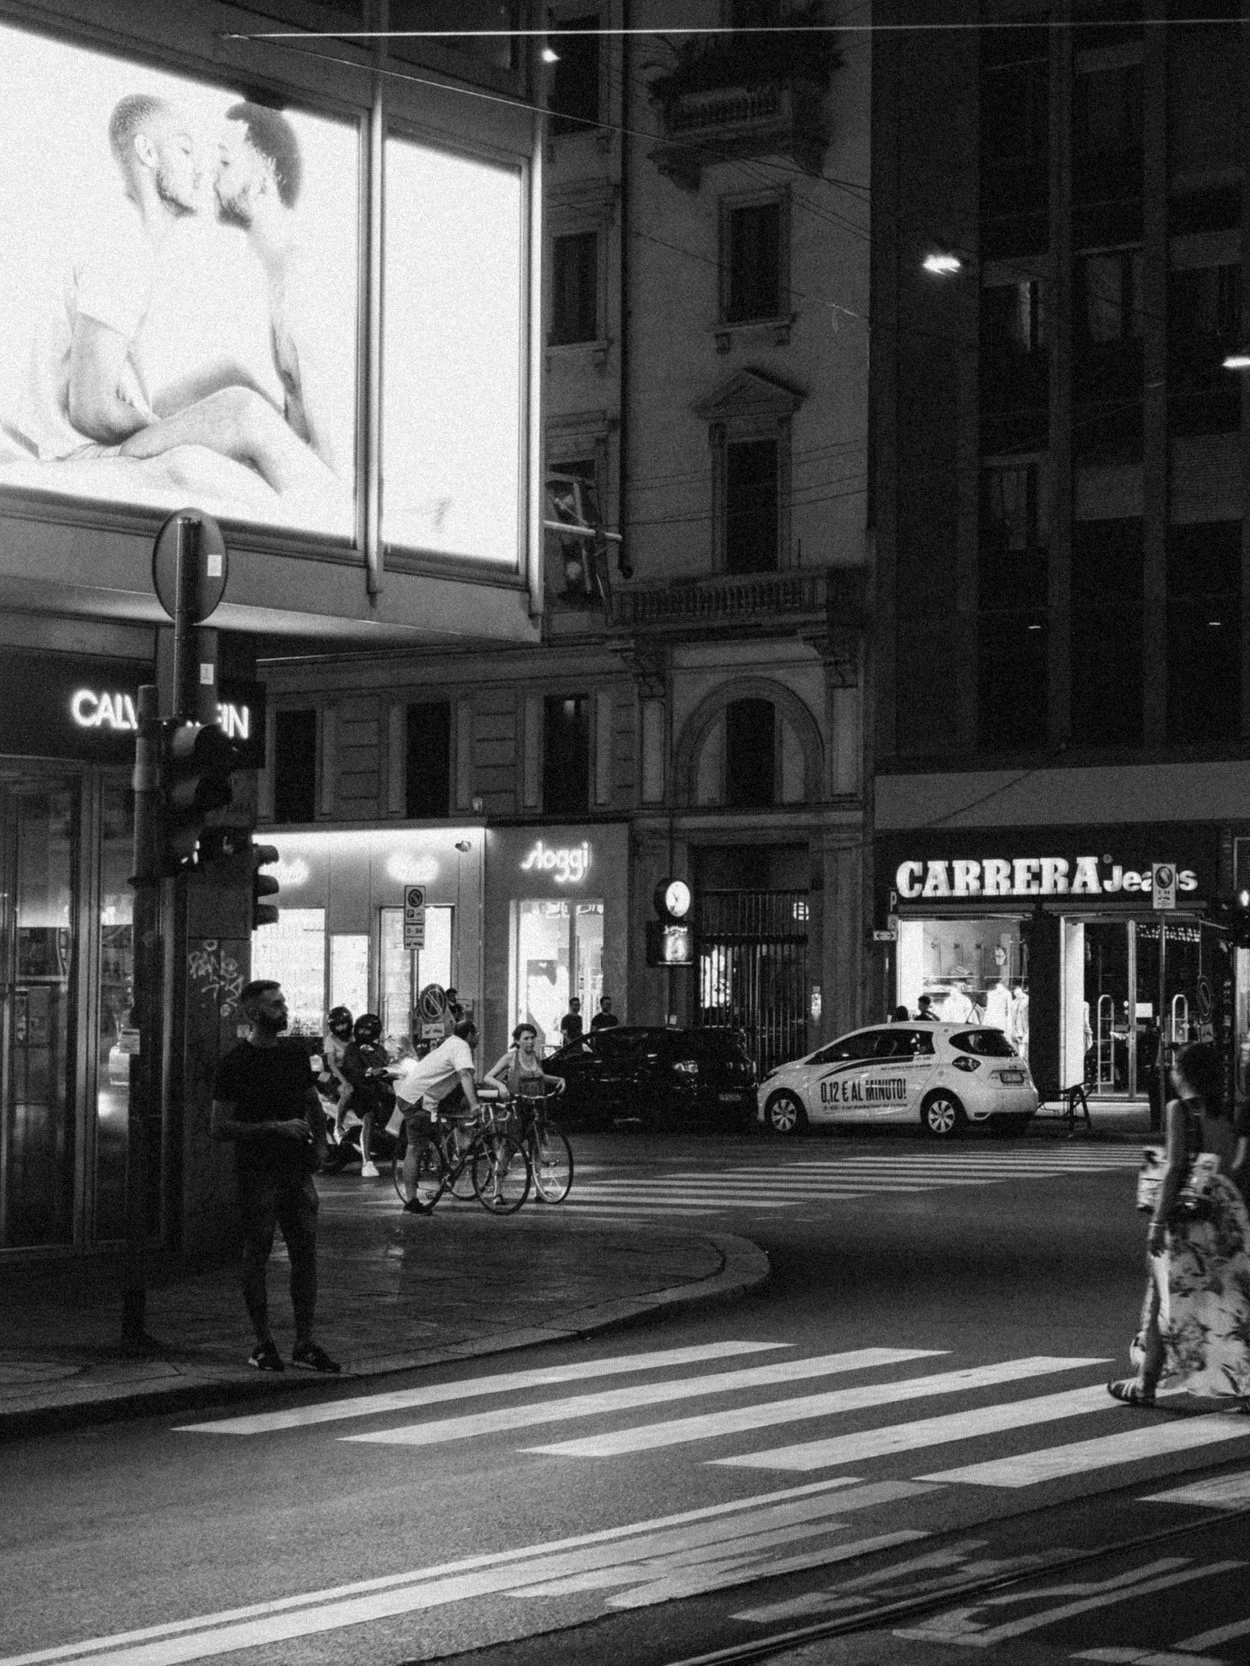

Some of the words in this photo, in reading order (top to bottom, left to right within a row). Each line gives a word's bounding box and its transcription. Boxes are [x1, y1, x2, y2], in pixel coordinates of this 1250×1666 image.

[521, 841, 590, 883] sloggi
[896, 856, 1103, 898] CARRERA
[1103, 864, 1199, 893] Jeas
[820, 1081, 840, 1105] 0,12
[841, 1082, 850, 1103] €
[851, 1081, 864, 1102] AL
[865, 1078, 907, 1101] MINUTO!
